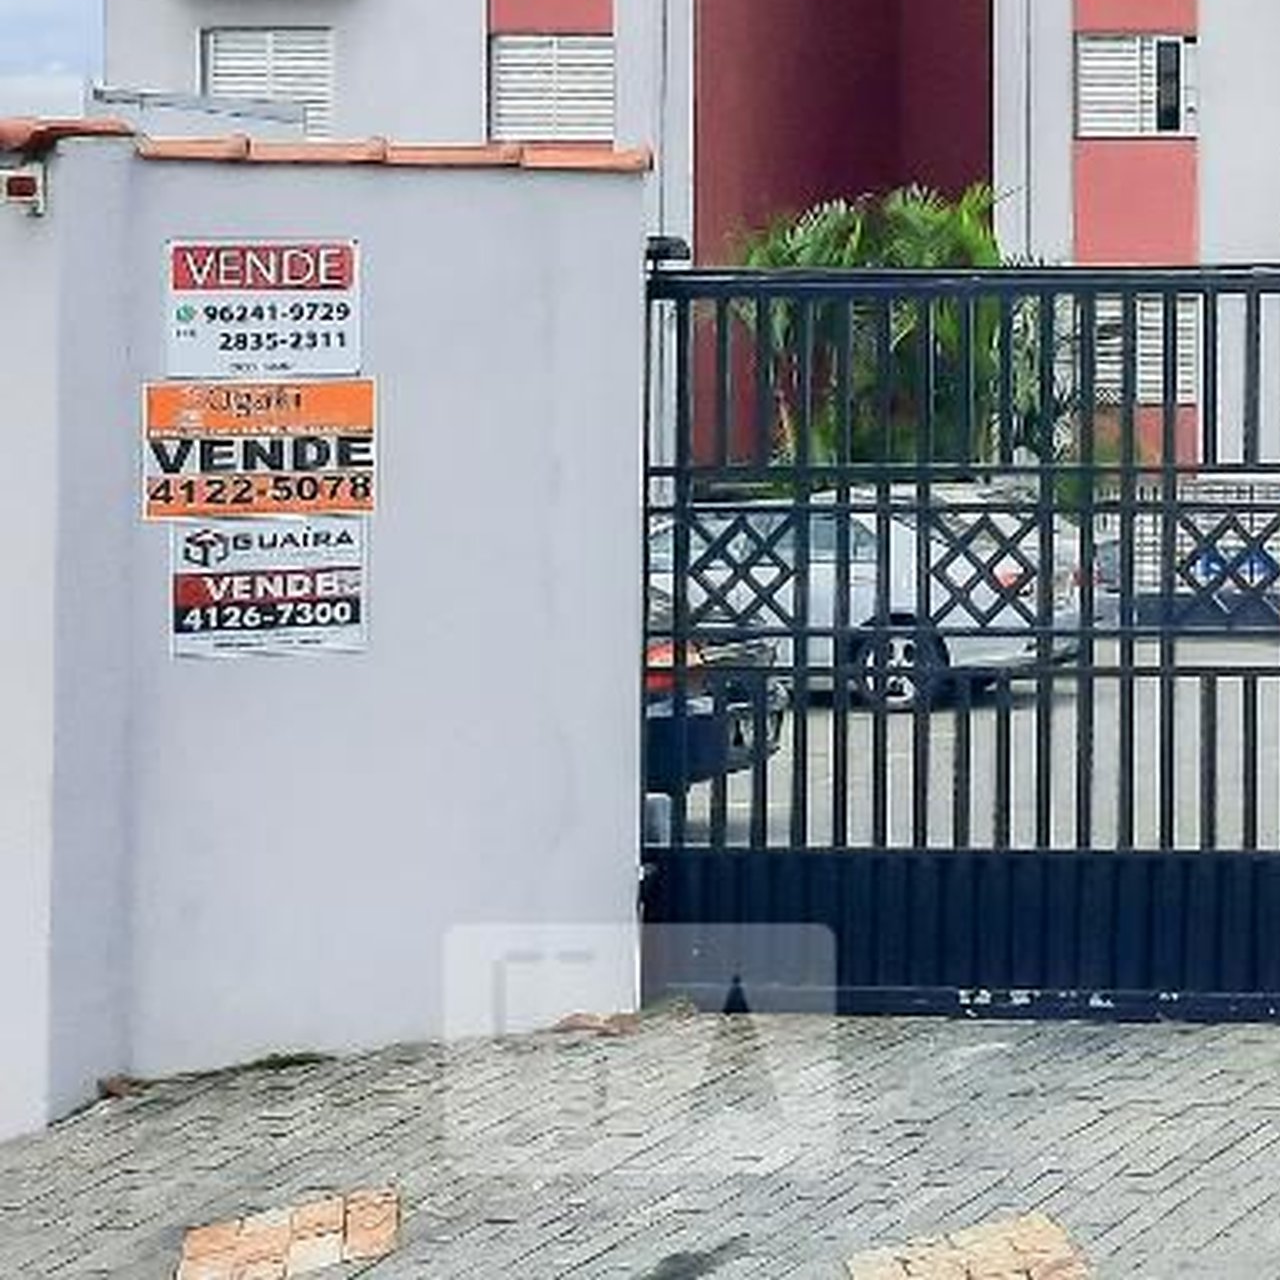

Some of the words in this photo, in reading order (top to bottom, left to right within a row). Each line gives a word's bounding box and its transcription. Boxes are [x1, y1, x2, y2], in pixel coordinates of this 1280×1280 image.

[186, 248, 342, 285] VENDE
[203, 302, 350, 322] 96241-9729
[151, 437, 374, 473] VENDE
[149, 475, 371, 504] 4122-5078
[202, 573, 337, 600] VENDE
[183, 602, 352, 631] 4126-7300
